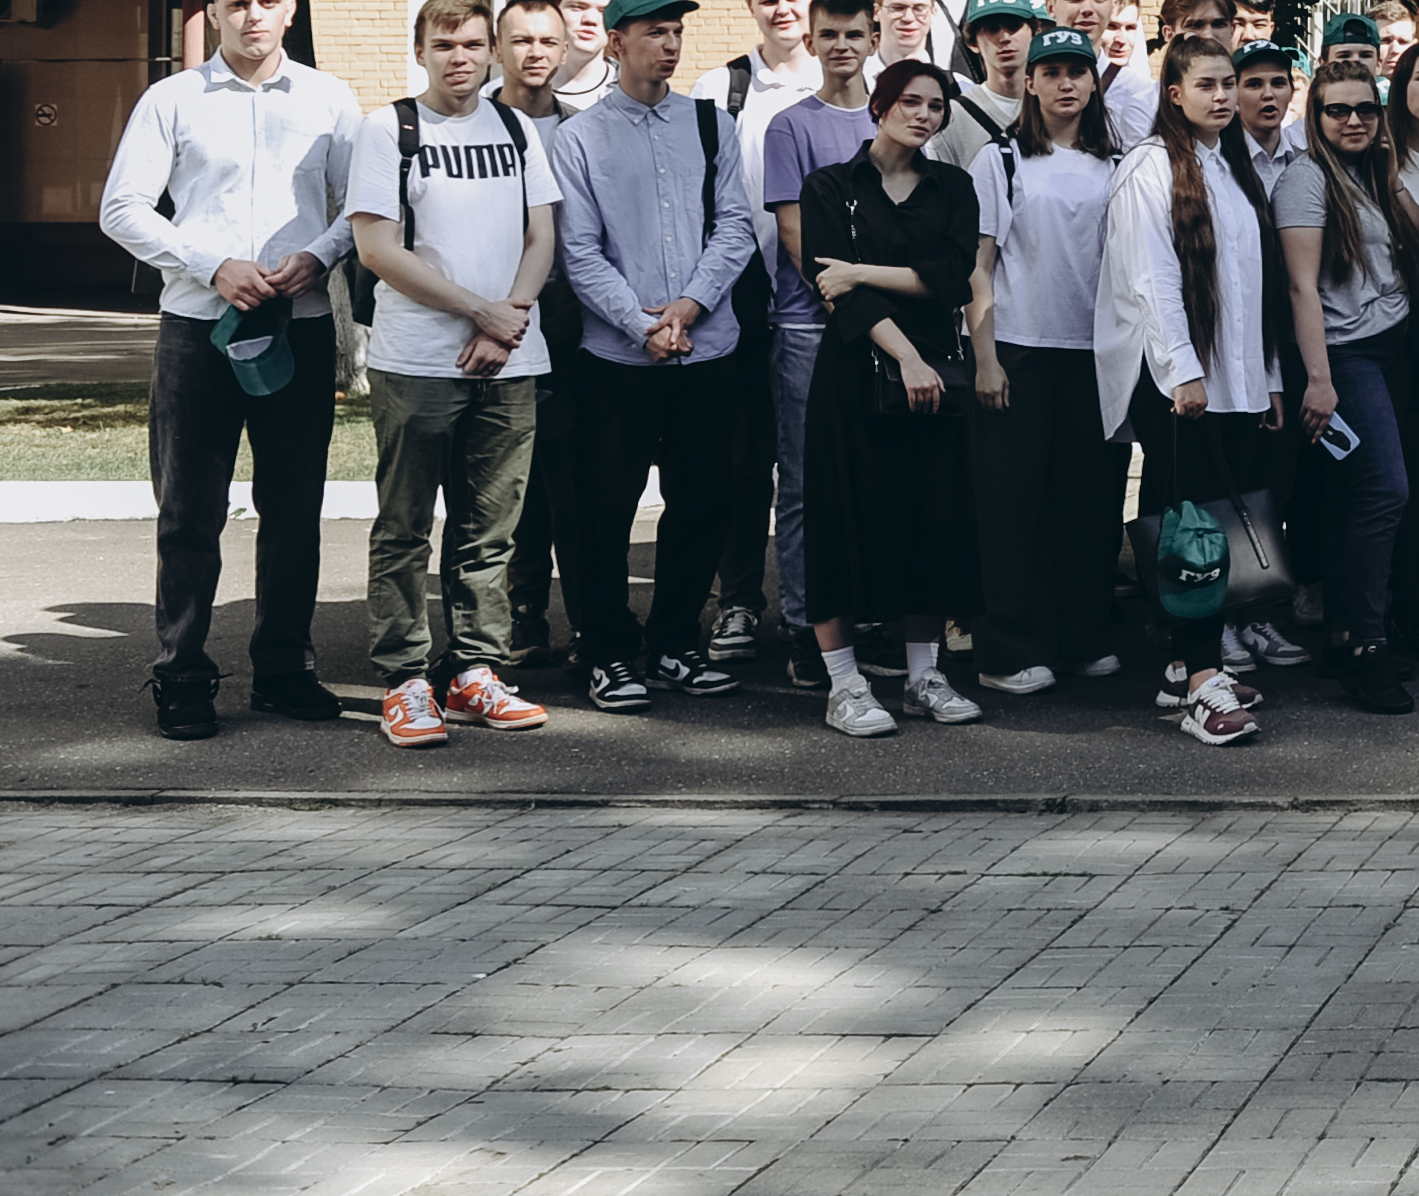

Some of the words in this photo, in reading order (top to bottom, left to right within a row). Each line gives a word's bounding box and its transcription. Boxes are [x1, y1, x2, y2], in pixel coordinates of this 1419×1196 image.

[1042, 30, 1083, 47] ГУЗ
[418, 143, 517, 179] PUMA
[1178, 567, 1221, 583] ГУЗ
